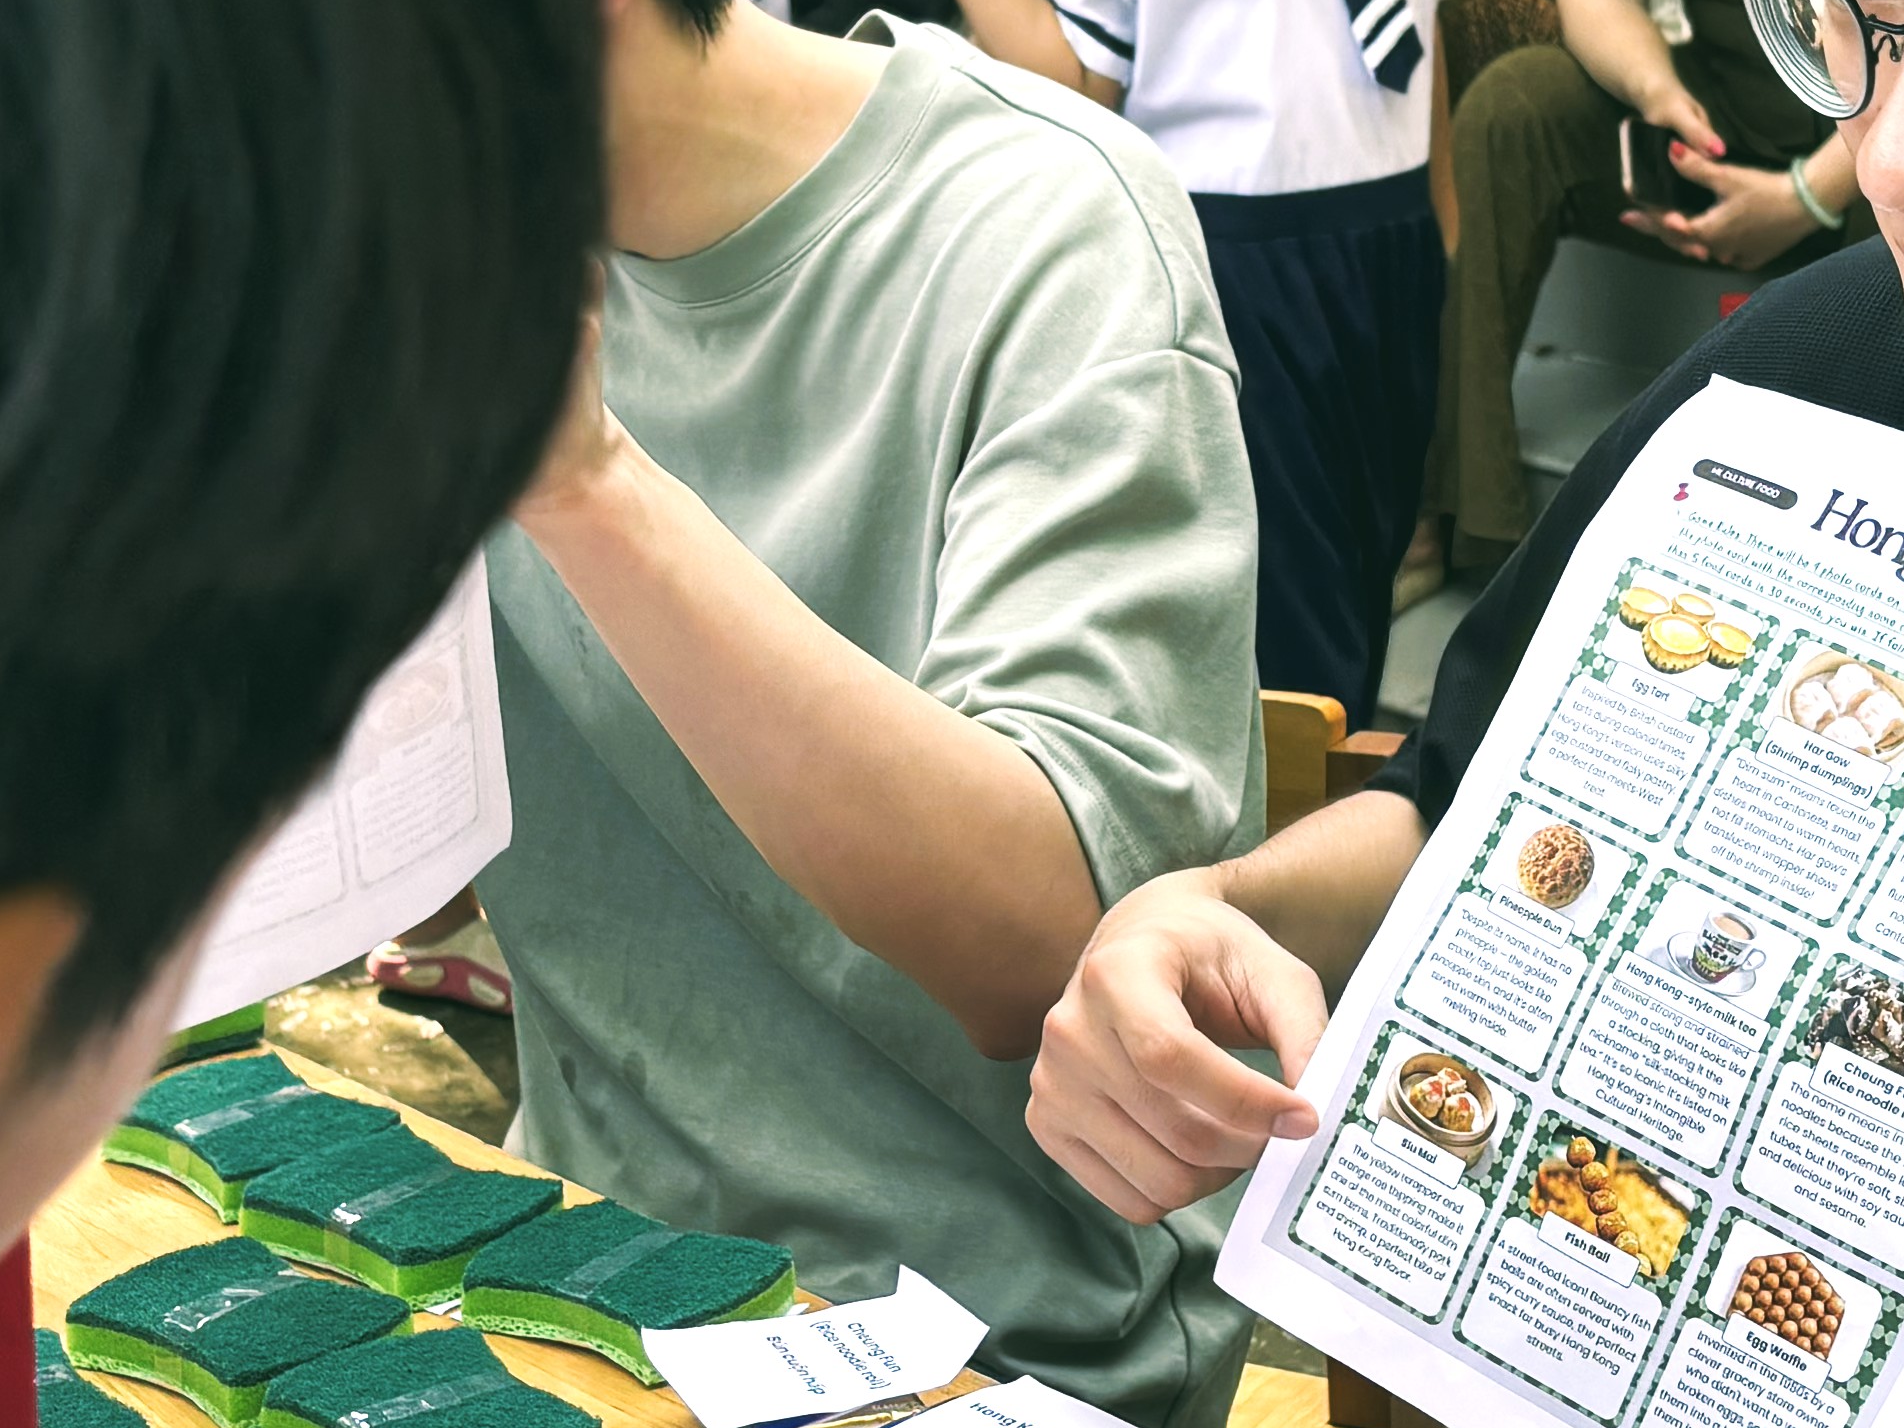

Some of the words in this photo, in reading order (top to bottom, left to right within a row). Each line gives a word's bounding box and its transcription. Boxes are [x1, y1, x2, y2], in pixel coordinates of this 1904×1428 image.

[1631, 678, 1649, 695] Egg
[1650, 685, 1669, 701] Tart
[1765, 740, 1809, 771] (Shrimp
[1810, 764, 1872, 799] dumplings)
[1803, 740, 1824, 755] Har
[1825, 750, 1850, 767] Gow
[1499, 895, 1542, 923] Pineapple
[1542, 918, 1562, 934] Bun
[1626, 962, 1654, 985] Hong
[1654, 976, 1712, 1013] Kong-style
[1713, 1009, 1737, 1027] milk
[1738, 1020, 1756, 1036] tea
[1587, 1064, 1615, 1089] Hong
[1616, 1080, 1651, 1106] Kong's
[1652, 1099, 1705, 1133] Intangible
[1823, 1069, 1854, 1093] (Rice
[1855, 1089, 1899, 1114] noodle
[1844, 1062, 1894, 1094] Cheung
[1595, 1088, 1638, 1116] Cultural
[1638, 1110, 1683, 1142] Heritage.
[1781, 1099, 1826, 1127] noodles
[1827, 1120, 1878, 1153] because
[1881, 1147, 1901, 1164] the
[1790, 1081, 1809, 1099] The
[1811, 1094, 1845, 1117] name
[1847, 1112, 1890, 1138] means
[1400, 1138, 1417, 1153] Siu
[1417, 1147, 1437, 1164] Mai
[1770, 1130, 1801, 1156] tubes,
[1804, 1148, 1824, 1166] but
[1826, 1160, 1865, 1186] they're
[1867, 1182, 1890, 1201] soft,
[1778, 1116, 1800, 1133] rice
[1801, 1129, 1839, 1153] sheets
[1840, 1149, 1896, 1182] resemble
[1758, 1146, 1782, 1163] and
[1782, 1158, 1832, 1189] delicious
[1834, 1185, 1858, 1203] with
[1859, 1198, 1881, 1216] soy
[1794, 1184, 1818, 1202] and
[1819, 1197, 1865, 1227] sesame.
[1564, 1231, 1586, 1250] Fish
[1587, 1244, 1610, 1263] Ball
[810, 1320, 839, 1342] (Rice
[833, 1343, 867, 1371] noodle
[862, 1372, 891, 1389] roll)
[848, 1323, 885, 1356] Cheung
[879, 1356, 901, 1372] Fun
[1746, 1330, 1768, 1353] Egg
[1770, 1343, 1807, 1371] Waffle
[970, 1403, 1016, 1426] Hong
